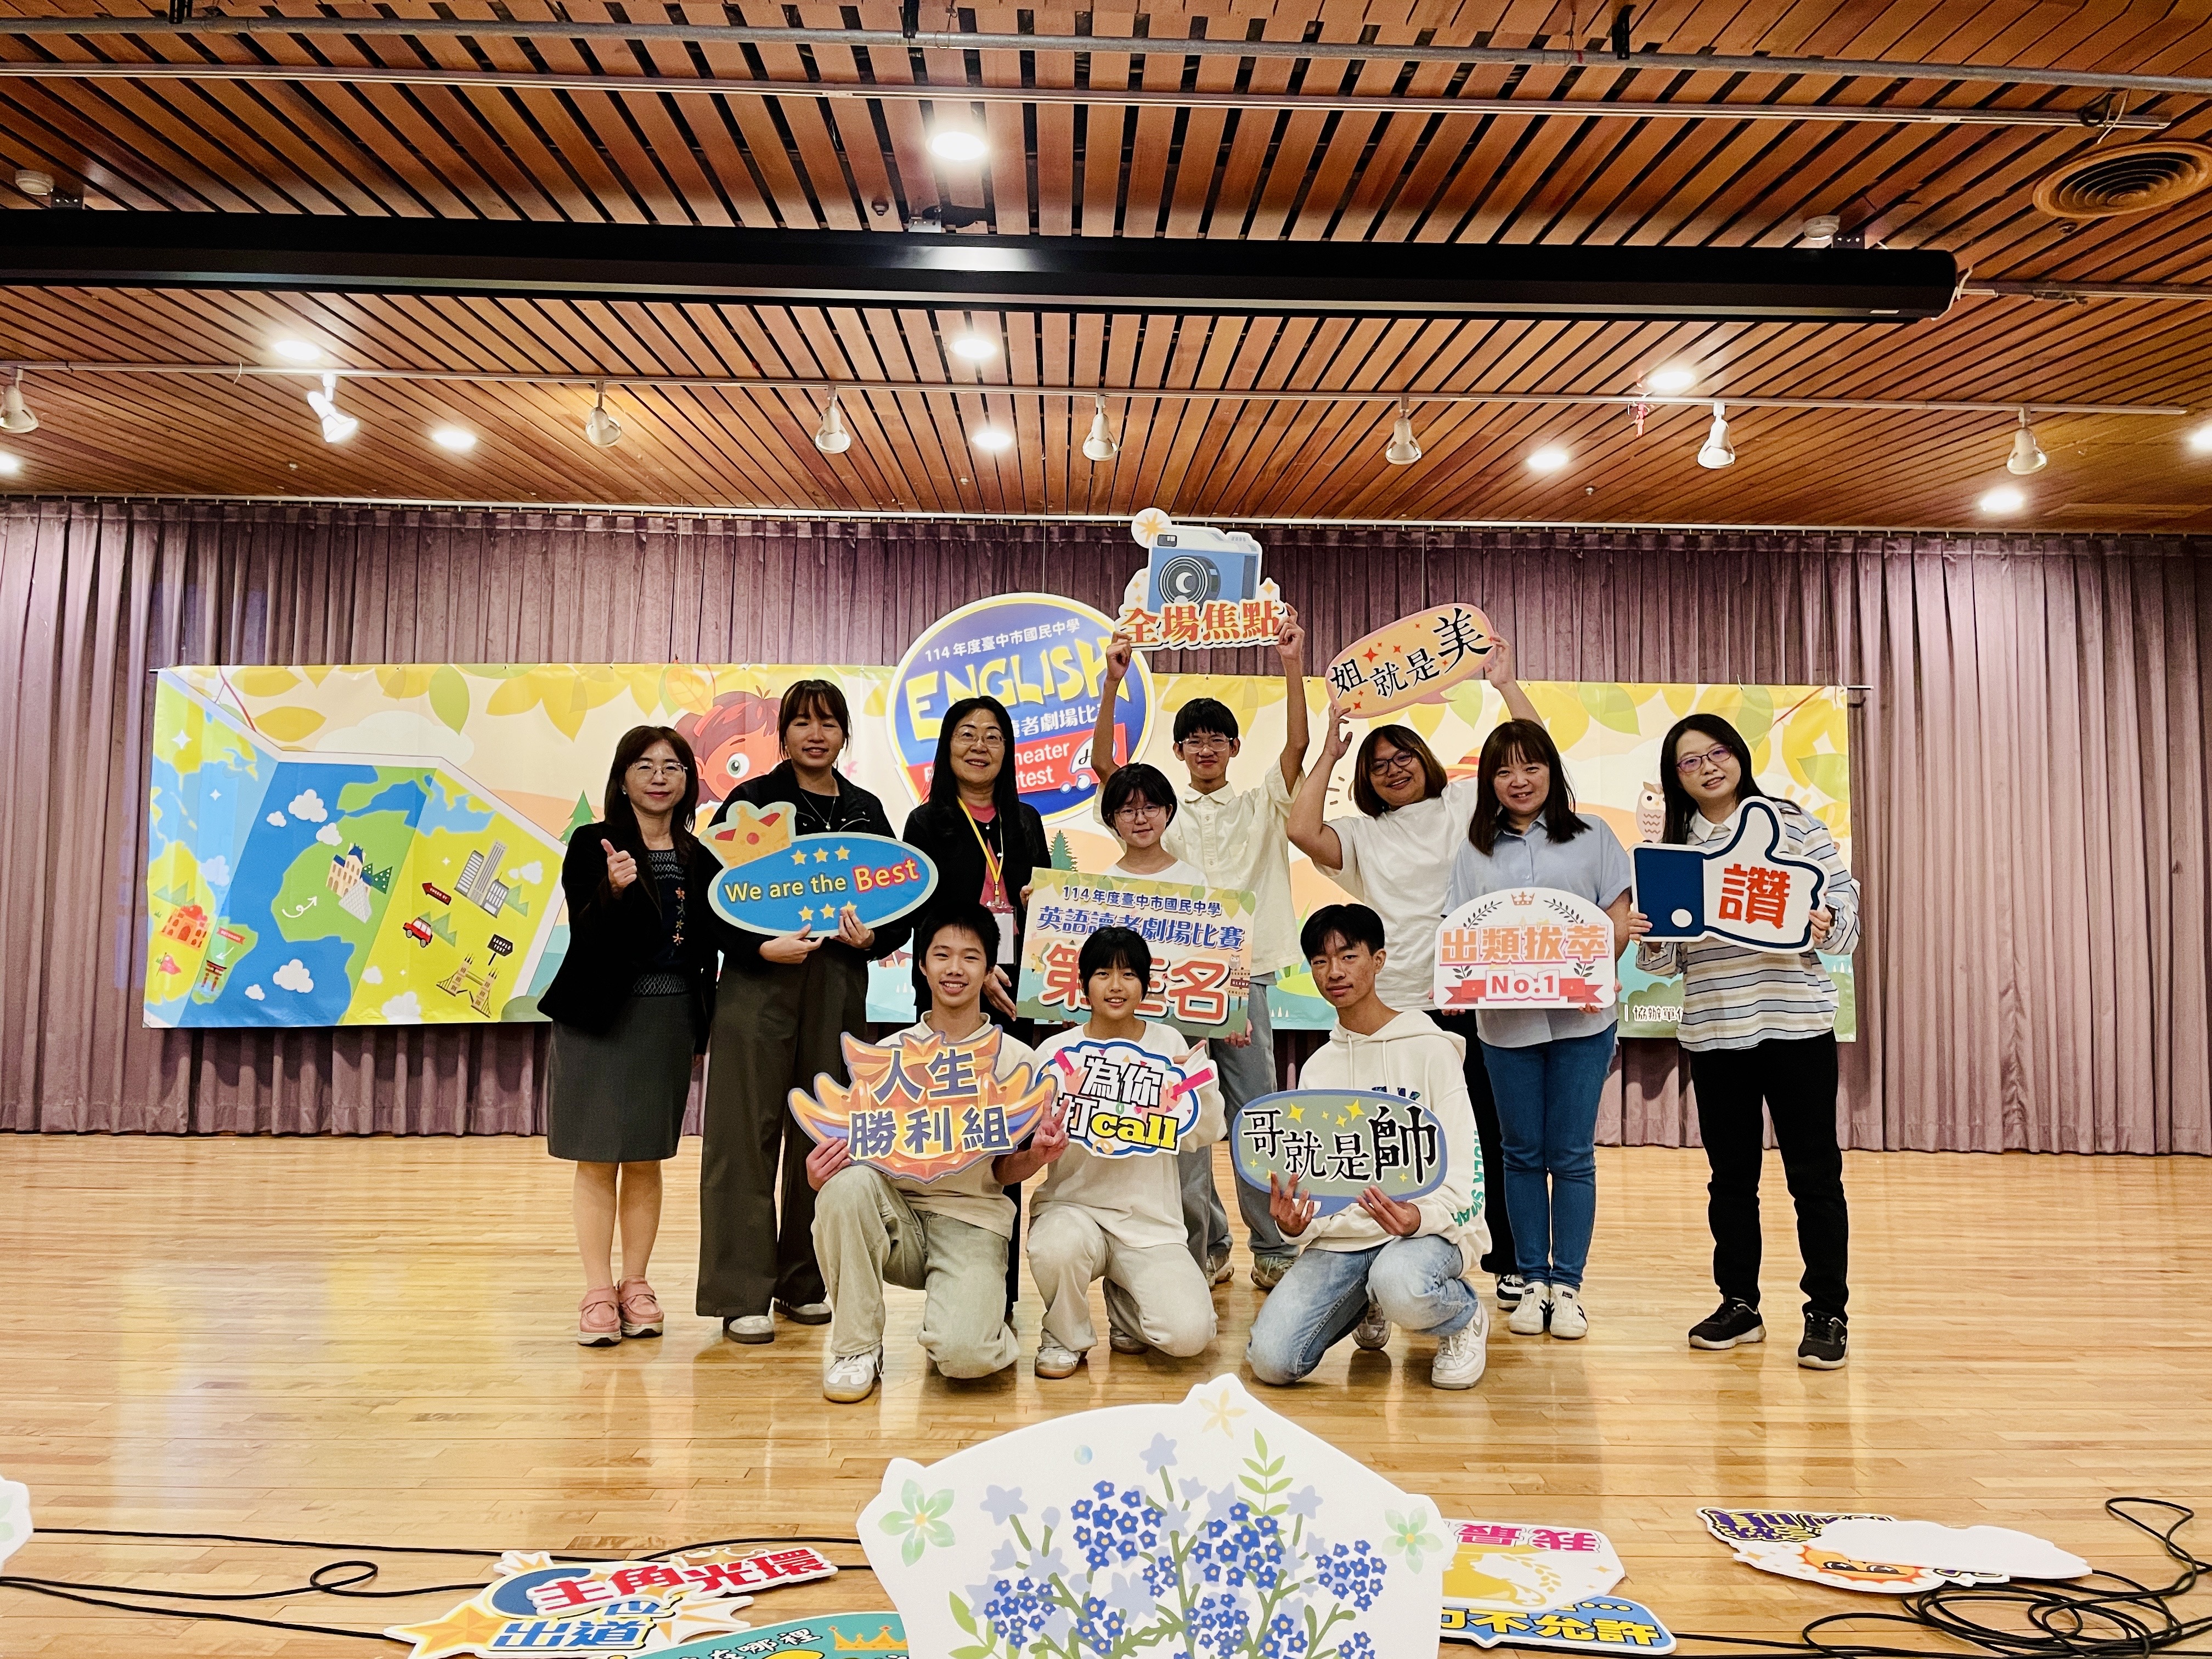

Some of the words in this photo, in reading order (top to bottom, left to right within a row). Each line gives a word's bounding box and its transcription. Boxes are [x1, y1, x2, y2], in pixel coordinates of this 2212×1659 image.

[926, 646, 950, 662] 114
[953, 618, 1080, 657] 年度臺中市國民中學
[1122, 599, 1280, 645] 全場焦點
[1330, 607, 1493, 698] 姐就是美
[906, 637, 1130, 741] ENGLISH
[725, 883, 761, 902] We
[770, 880, 804, 898] are
[810, 874, 847, 894] the
[854, 859, 919, 893] Best
[1062, 886, 1090, 901] 114
[1092, 889, 1222, 917] 年度臺中市國民中學
[1718, 863, 1791, 929] 讚
[1442, 924, 1607, 963] 出類拔萃
[1491, 974, 1556, 994] No.1
[873, 1048, 977, 1105] 人生
[1079, 1056, 1164, 1108] 為你
[849, 1107, 1012, 1159] 勝利組
[1242, 1105, 1437, 1184] 哥就是帥
[533, 1549, 827, 1611] 主角光環
[492, 1620, 647, 1647] 出道
[679, 1628, 822, 1659] 在哪裡
